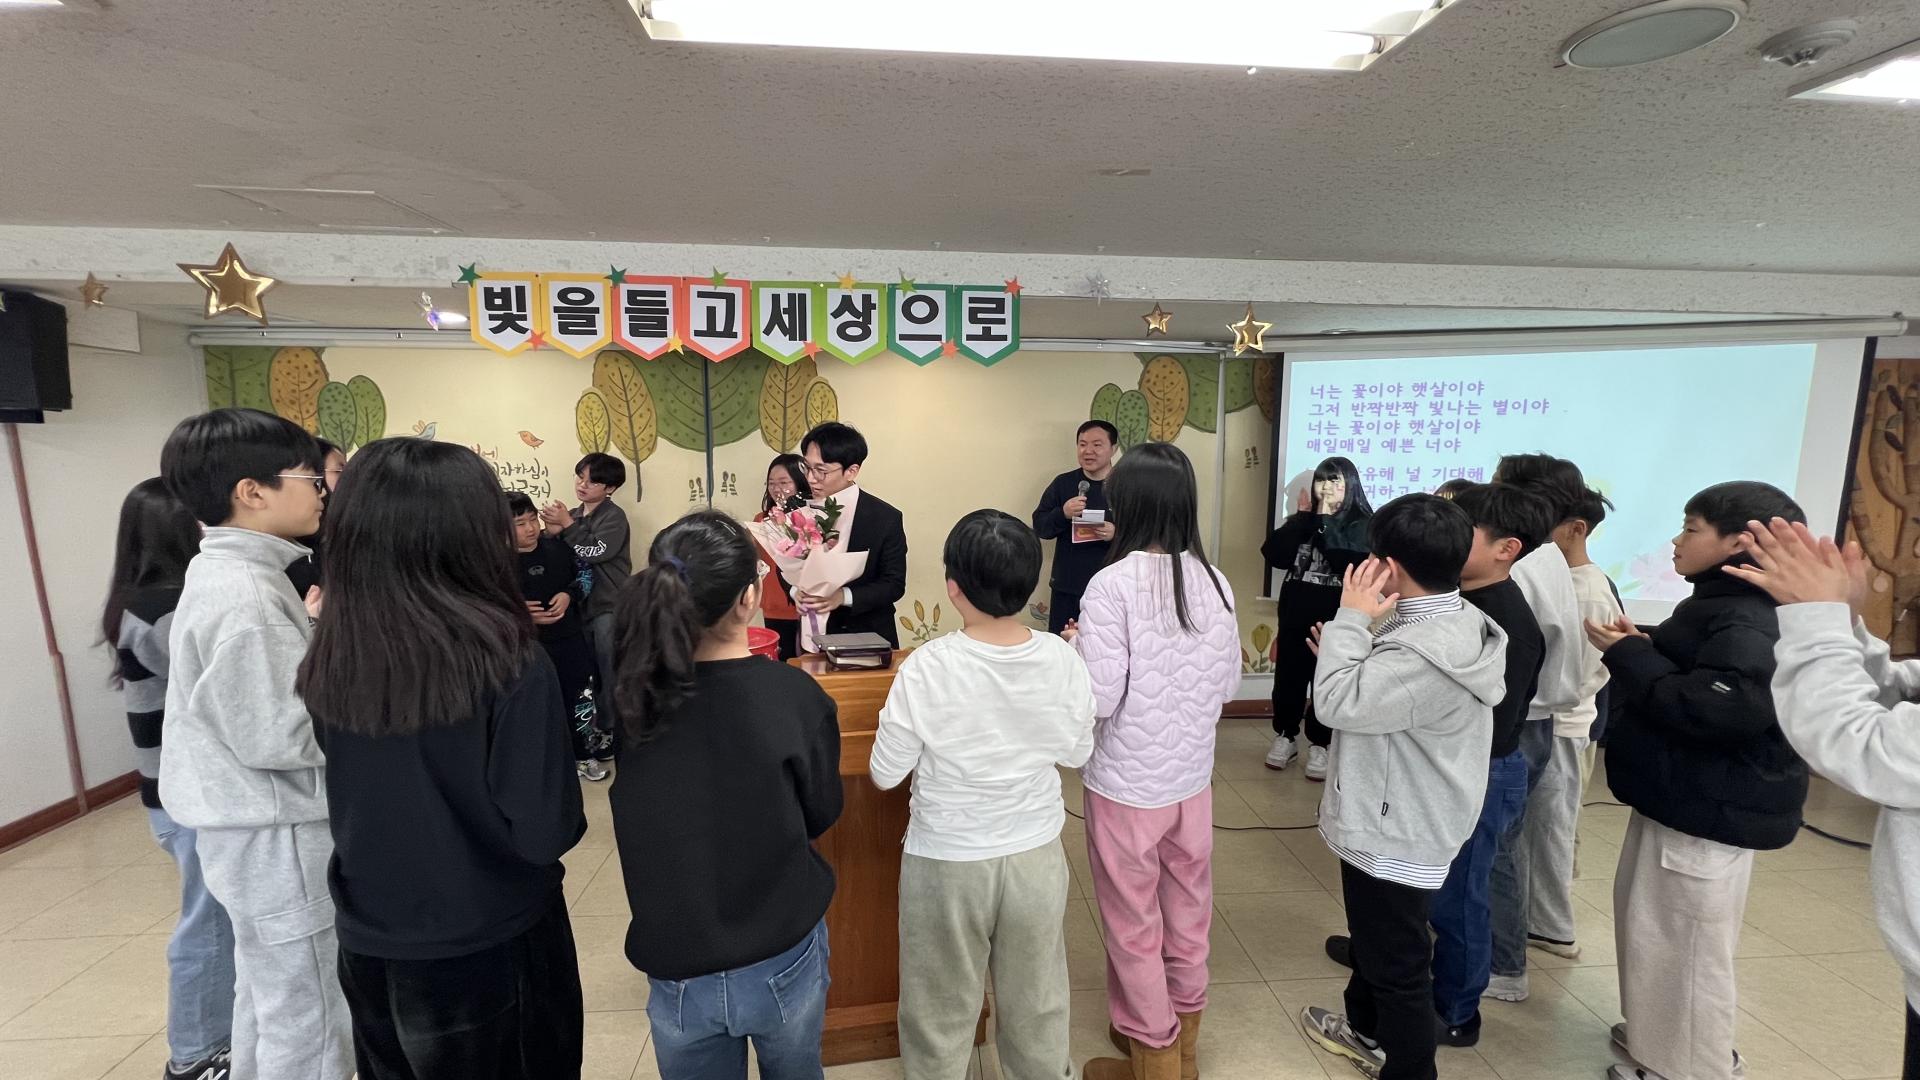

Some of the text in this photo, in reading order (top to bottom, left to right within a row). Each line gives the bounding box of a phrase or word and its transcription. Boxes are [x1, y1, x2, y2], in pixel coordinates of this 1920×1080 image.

[1310, 380, 1485, 399] 너는 꽃이야 햇살이야
[1308, 398, 1550, 417] 그저 반짝반짝 빛나는 별이야
[1308, 418, 1481, 435] 너는 꽃이야 햇살이야
[1306, 437, 1461, 453] 매일매일 예쁜 너야
[1357, 465, 1484, 482] 유해 널 기대해
